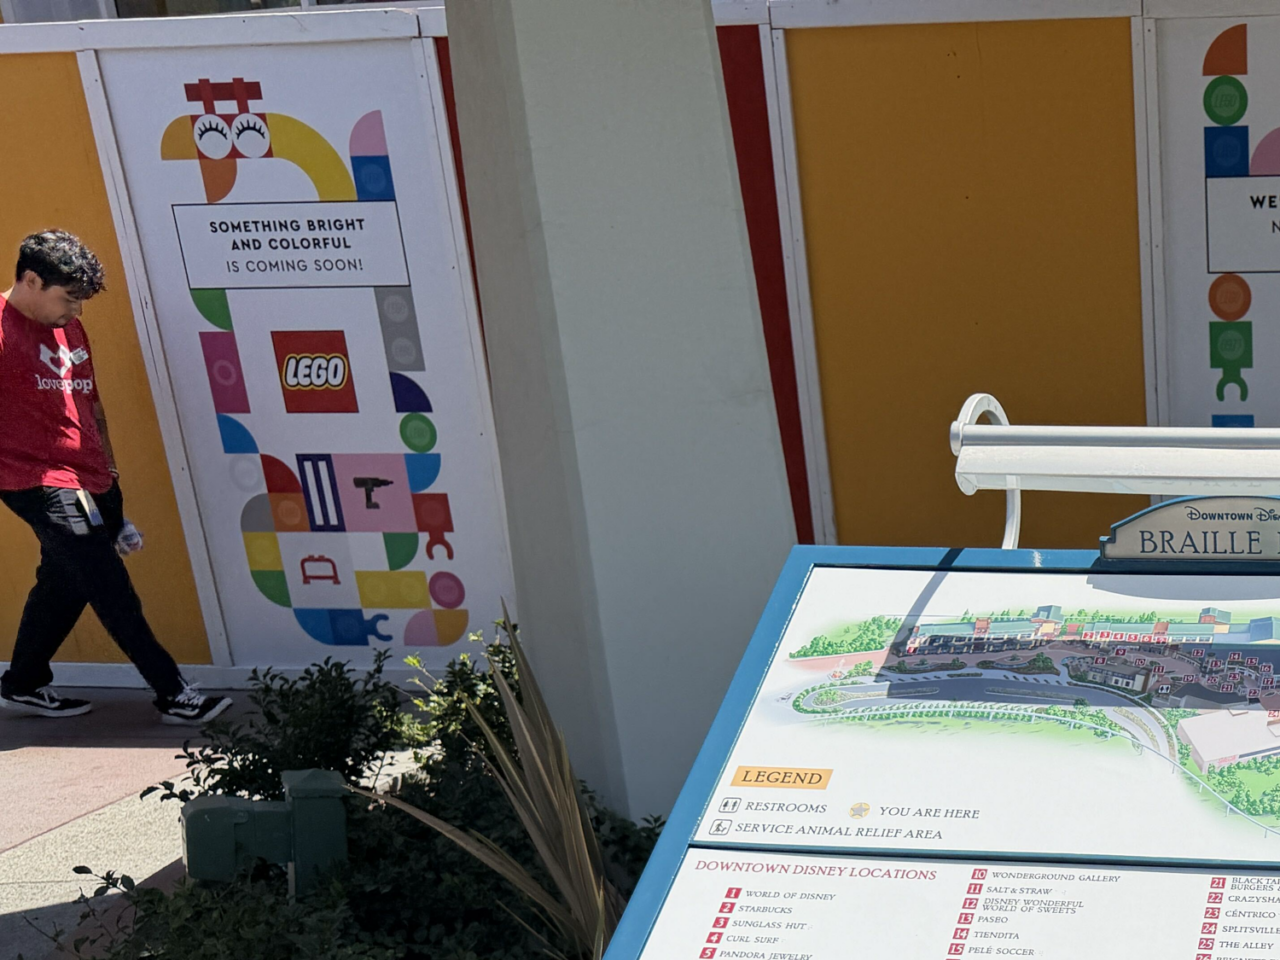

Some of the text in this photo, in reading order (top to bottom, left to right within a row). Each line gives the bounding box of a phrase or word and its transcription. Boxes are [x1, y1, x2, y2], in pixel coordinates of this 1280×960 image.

[210, 218, 365, 233] SOMETHING BRIGHT
[232, 237, 351, 251] AND COLORFUL
[227, 259, 363, 272] IS COMING SOON!
[284, 355, 346, 387] LEGO
[35, 374, 92, 394] lovepop
[1139, 531, 1262, 554] BRAILLE
[741, 770, 822, 785] LEGEND
[745, 802, 828, 813] RESTROOMS
[880, 806, 980, 819] YOU ARE HERE
[735, 822, 942, 839] SERVICE ANIMAL RELIEF AREA
[695, 861, 937, 880] DOWNTOWN DISNEY LOCATIONS
[974, 870, 986, 879] 10
[993, 872, 1075, 881] WONDERGROUND
[746, 890, 780, 898] WORLD
[738, 906, 792, 914] STARBUCKS
[1206, 909, 1219, 918] 23
[960, 915, 972, 923] 13
[732, 920, 782, 929] SUNGLASS
[785, 922, 806, 930] HUT
[1203, 924, 1216, 933] 24
[754, 936, 779, 944] SURF
[955, 930, 967, 939] 14
[1200, 940, 1213, 949] 25
[719, 951, 765, 960] PANDORA
[768, 952, 813, 960] JEWELRY
[950, 945, 963, 954] 15
[996, 948, 1034, 956] SOCCER
